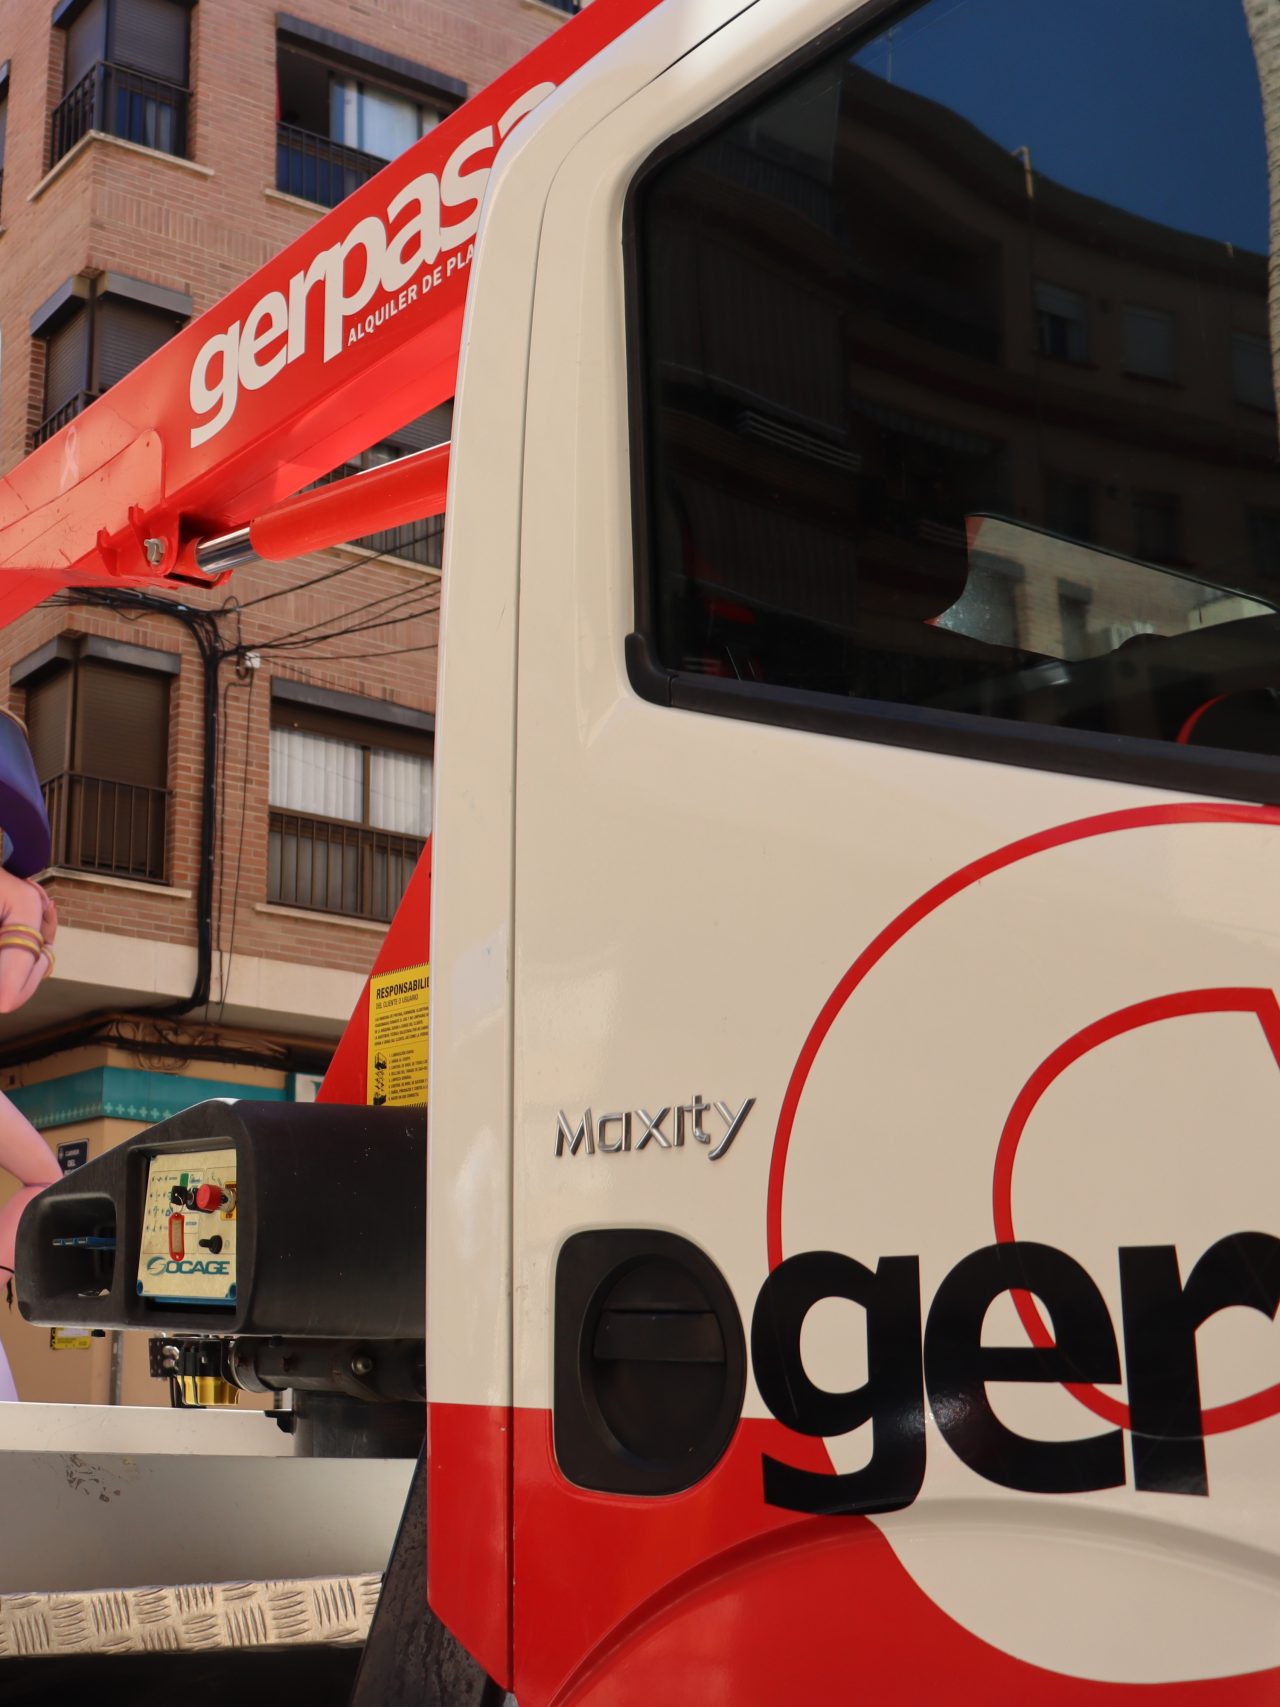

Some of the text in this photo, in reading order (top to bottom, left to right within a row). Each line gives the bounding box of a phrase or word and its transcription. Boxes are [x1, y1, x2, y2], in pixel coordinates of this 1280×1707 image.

[189, 81, 556, 448] gerpas
[347, 285, 418, 346] ALQUILER
[422, 268, 442, 297] DE
[554, 1095, 756, 1160] Maxity
[147, 1255, 230, 1276] SOCAGE
